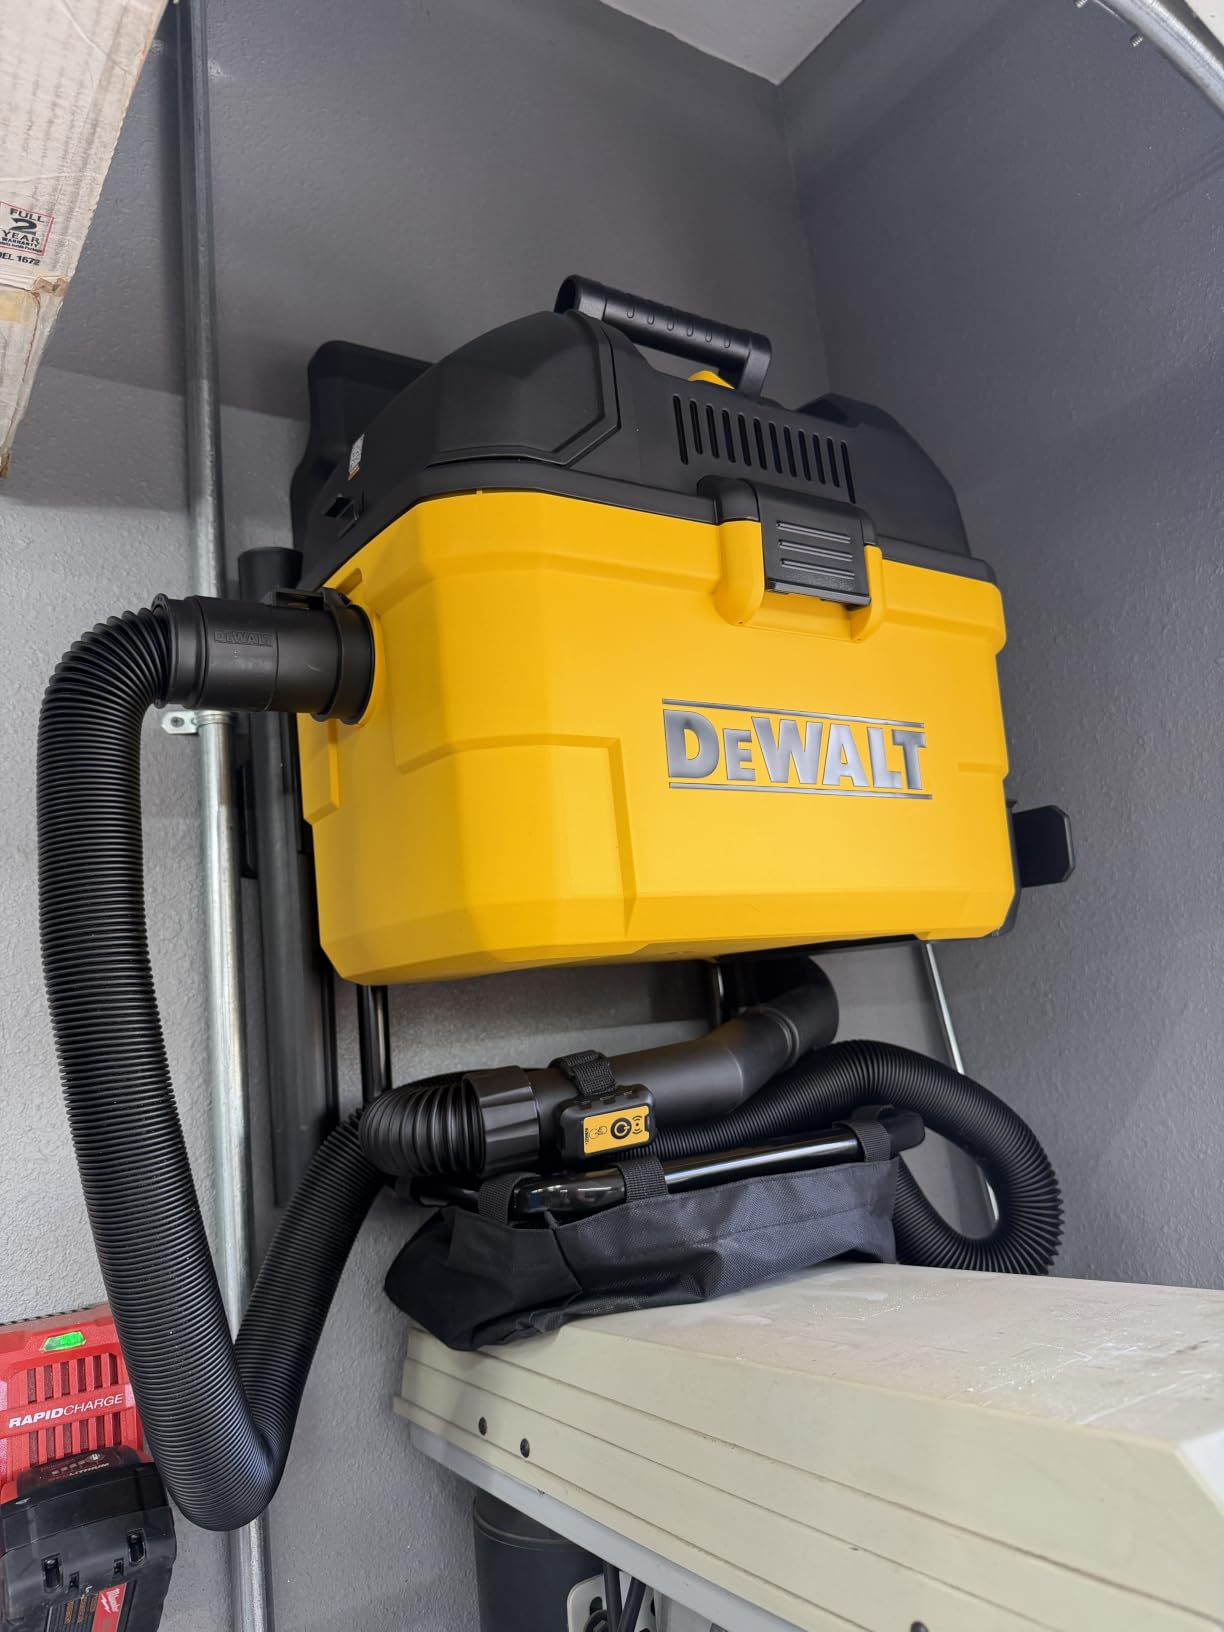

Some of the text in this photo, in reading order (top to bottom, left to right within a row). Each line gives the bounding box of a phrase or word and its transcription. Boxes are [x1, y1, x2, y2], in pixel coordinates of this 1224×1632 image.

[10, 208, 45, 223] FULL
[9, 217, 37, 236] 2
[1, 229, 40, 244] YEAR
[2, 237, 38, 248] WARRANTY
[17, 255, 41, 266] 1672
[9, 1394, 124, 1429] RAPIDCHARGE
